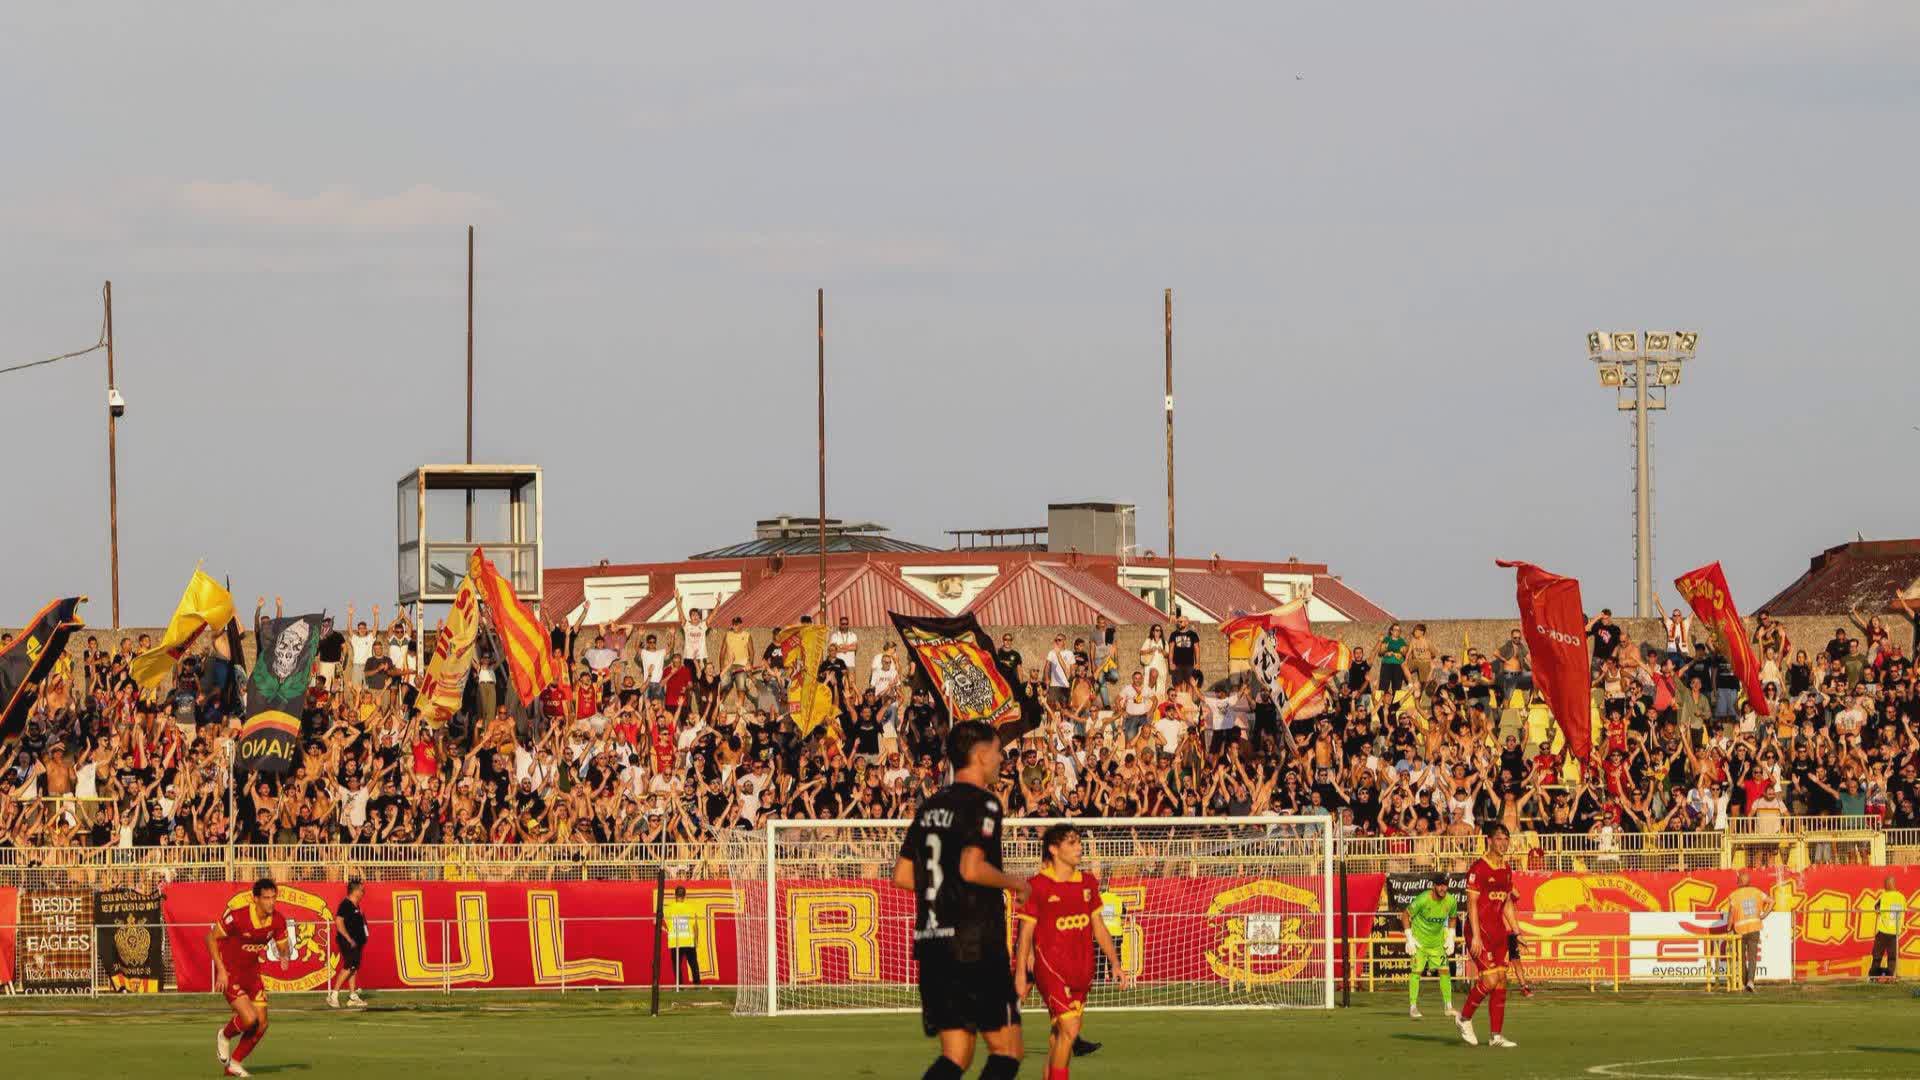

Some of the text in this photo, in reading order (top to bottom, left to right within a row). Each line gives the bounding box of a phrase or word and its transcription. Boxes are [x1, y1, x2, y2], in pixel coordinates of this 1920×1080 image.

[925, 834, 944, 900] 3
[1402, 878, 1457, 891] quell'alo
[1489, 891, 1507, 902] coop
[32, 897, 82, 913] BESIDE
[42, 915, 76, 932] THE
[1056, 914, 1089, 931] coop
[26, 934, 89, 951] EAGLES
[1506, 965, 1607, 977] eportwear.com
[1652, 965, 1767, 978] eyesportweam
